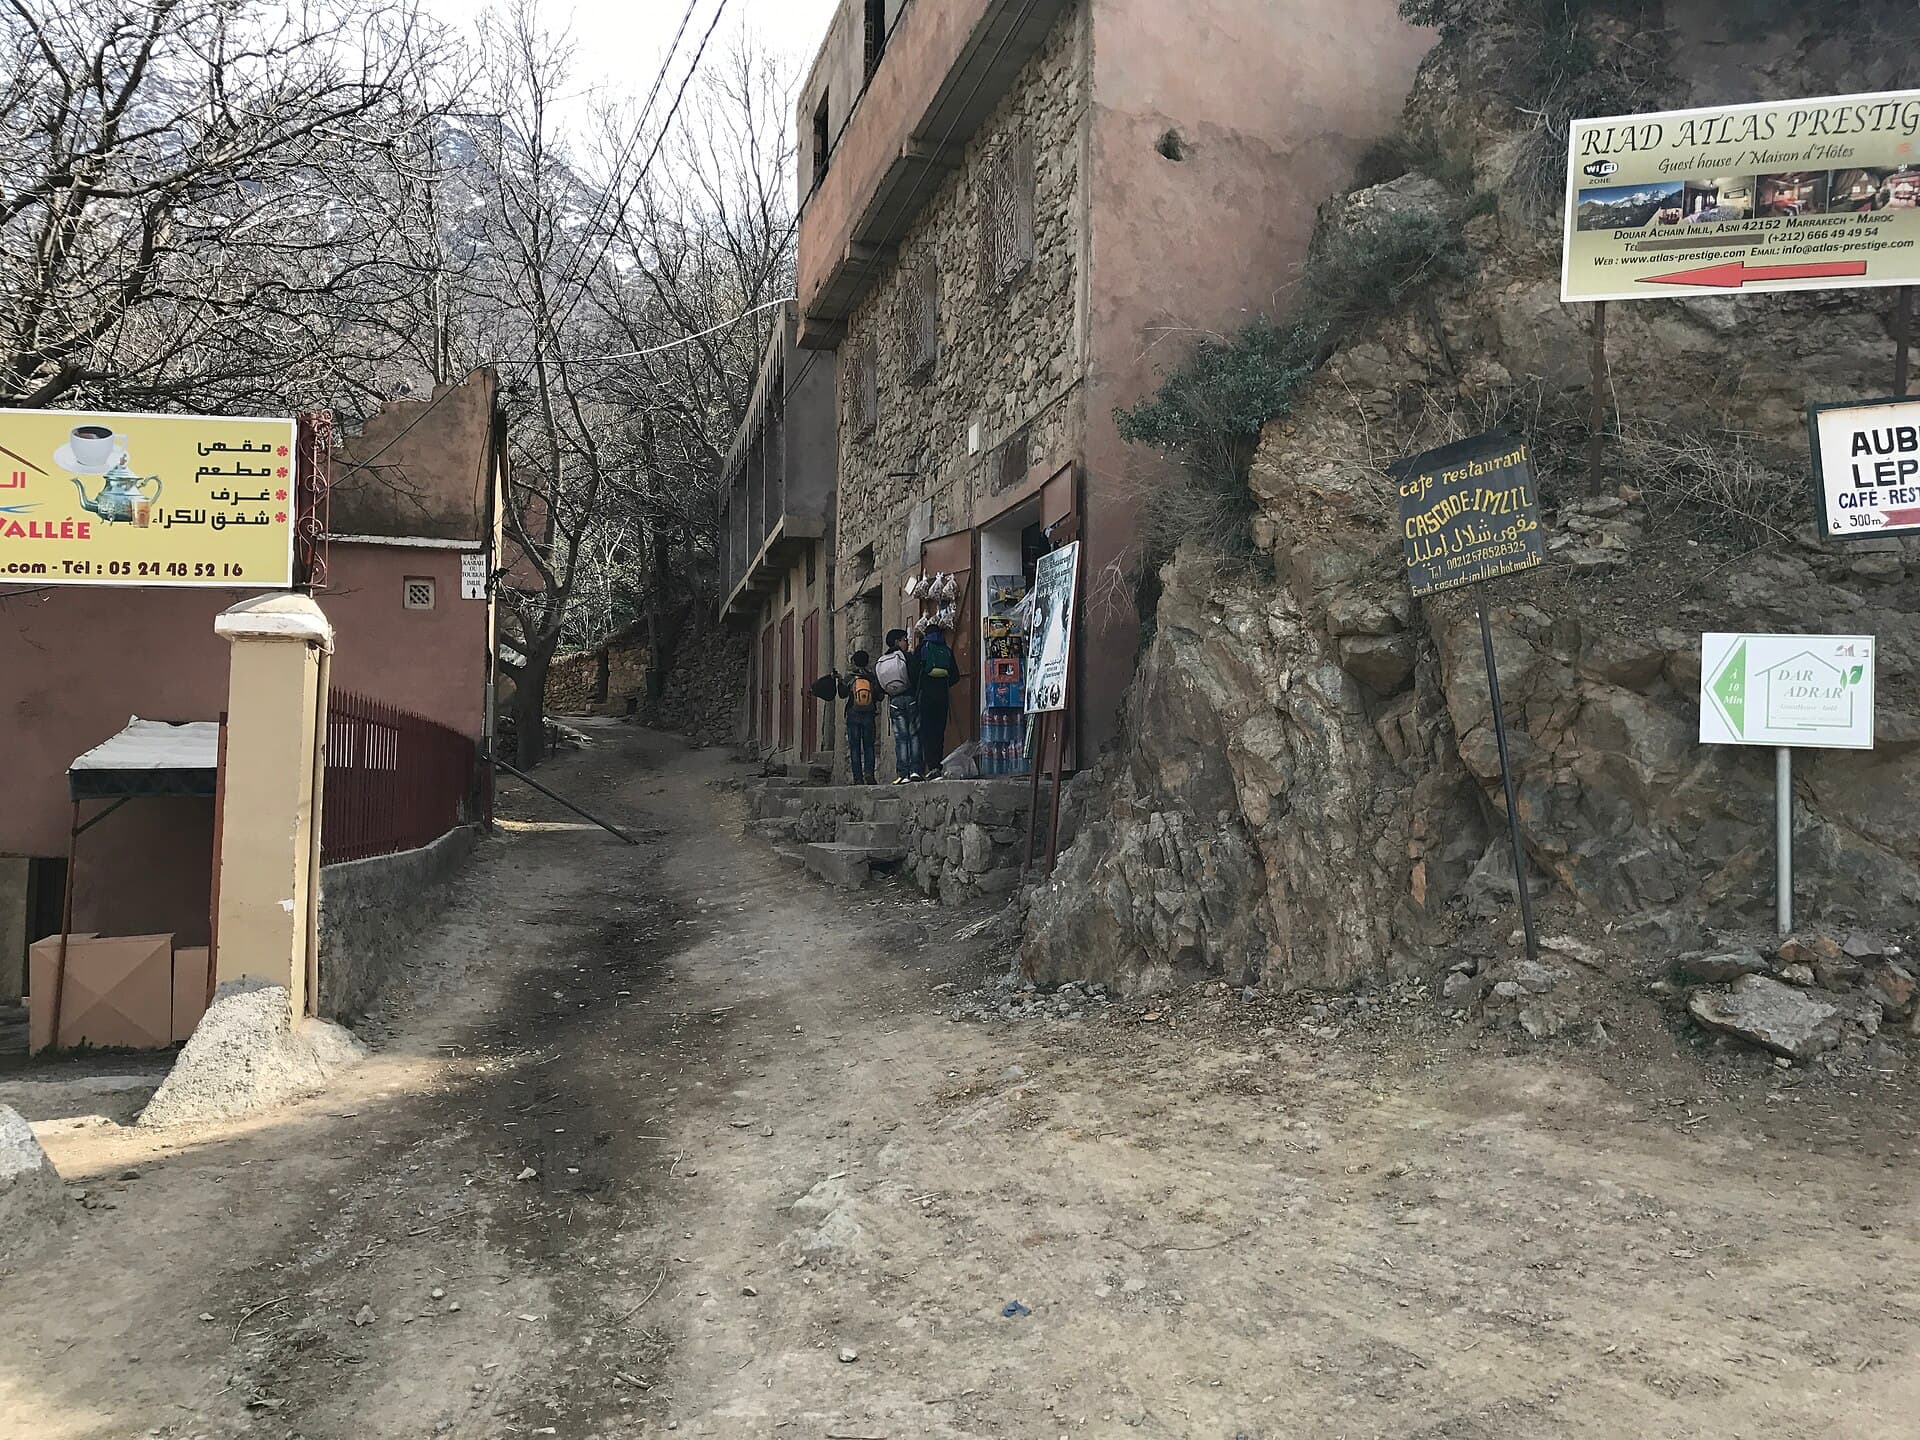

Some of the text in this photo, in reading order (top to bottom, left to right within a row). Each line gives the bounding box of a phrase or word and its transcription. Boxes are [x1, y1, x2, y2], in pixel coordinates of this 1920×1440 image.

[1581, 99, 1920, 156] RIAD ATLAS PRESTIG
[1658, 155, 1695, 174] Guest
[1697, 152, 1732, 169] house
[1750, 150, 1799, 165] Maison
[1802, 143, 1855, 160] d'Hôtes
[1742, 219, 1781, 231] 42152
[1768, 233, 1805, 244] (+212)
[1807, 230, 1828, 240] 666
[1830, 229, 1847, 238] 49
[1847, 228, 1862, 237] 49
[1865, 227, 1878, 236] 54
[1621, 248, 1746, 265] www.atlas-prestige.com
[1782, 240, 1914, 256] info@atlas-prestige.com
[197, 440, 272, 457] مقهى
[1852, 425, 1920, 457] AUB
[195, 461, 271, 483] مطعم
[1442, 444, 1527, 486] restaurant
[0, 471, 26, 489] ال
[211, 487, 270, 506] غرف
[151, 508, 270, 530] شقق للكراء
[62, 561, 90, 575] Tél
[109, 561, 131, 576] 05
[138, 562, 160, 577] 24
[166, 562, 188, 577] 48
[194, 563, 215, 577] 52
[223, 563, 244, 577] 16
[1778, 669, 1814, 682] DAR
[1728, 682, 1739, 691] 10
[1784, 686, 1843, 699] ADRAR
[1724, 695, 1743, 705] Min
